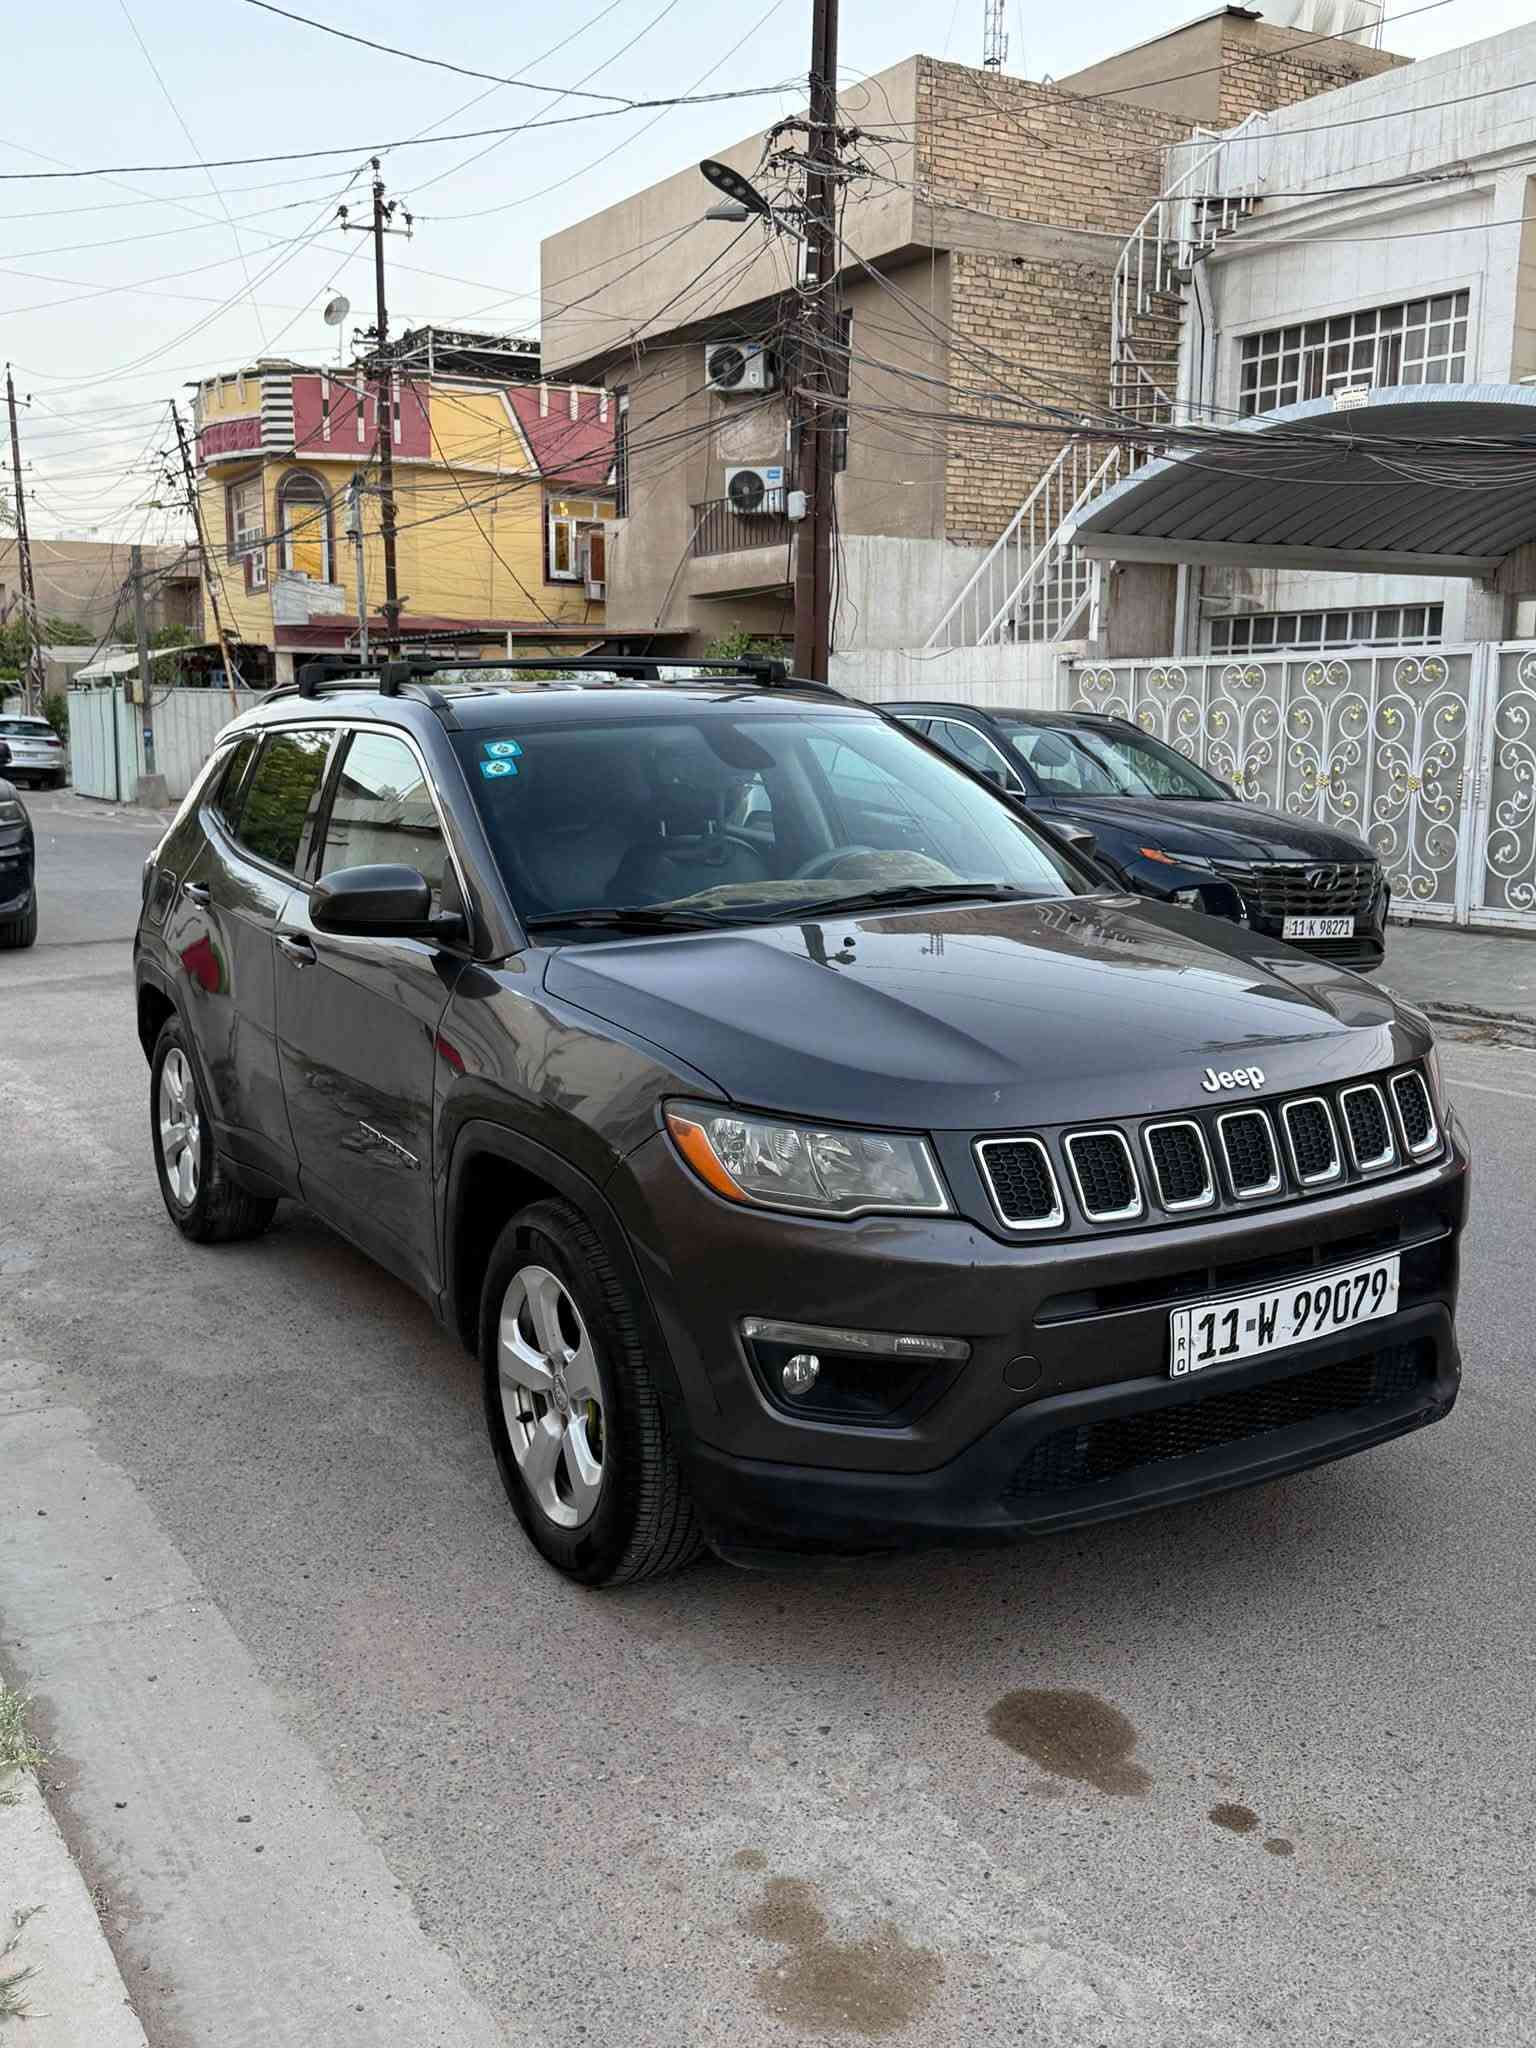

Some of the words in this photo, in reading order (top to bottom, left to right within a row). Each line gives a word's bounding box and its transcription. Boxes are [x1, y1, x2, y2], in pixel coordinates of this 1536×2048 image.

[1291, 920, 1305, 936] 11
[1308, 919, 1317, 936] K
[1320, 919, 1350, 936] 98271
[1202, 1066, 1265, 1092] Jeep
[1198, 1308, 1240, 1361] 11
[1257, 1299, 1280, 1346] W
[1292, 1268, 1388, 1337] 99079
